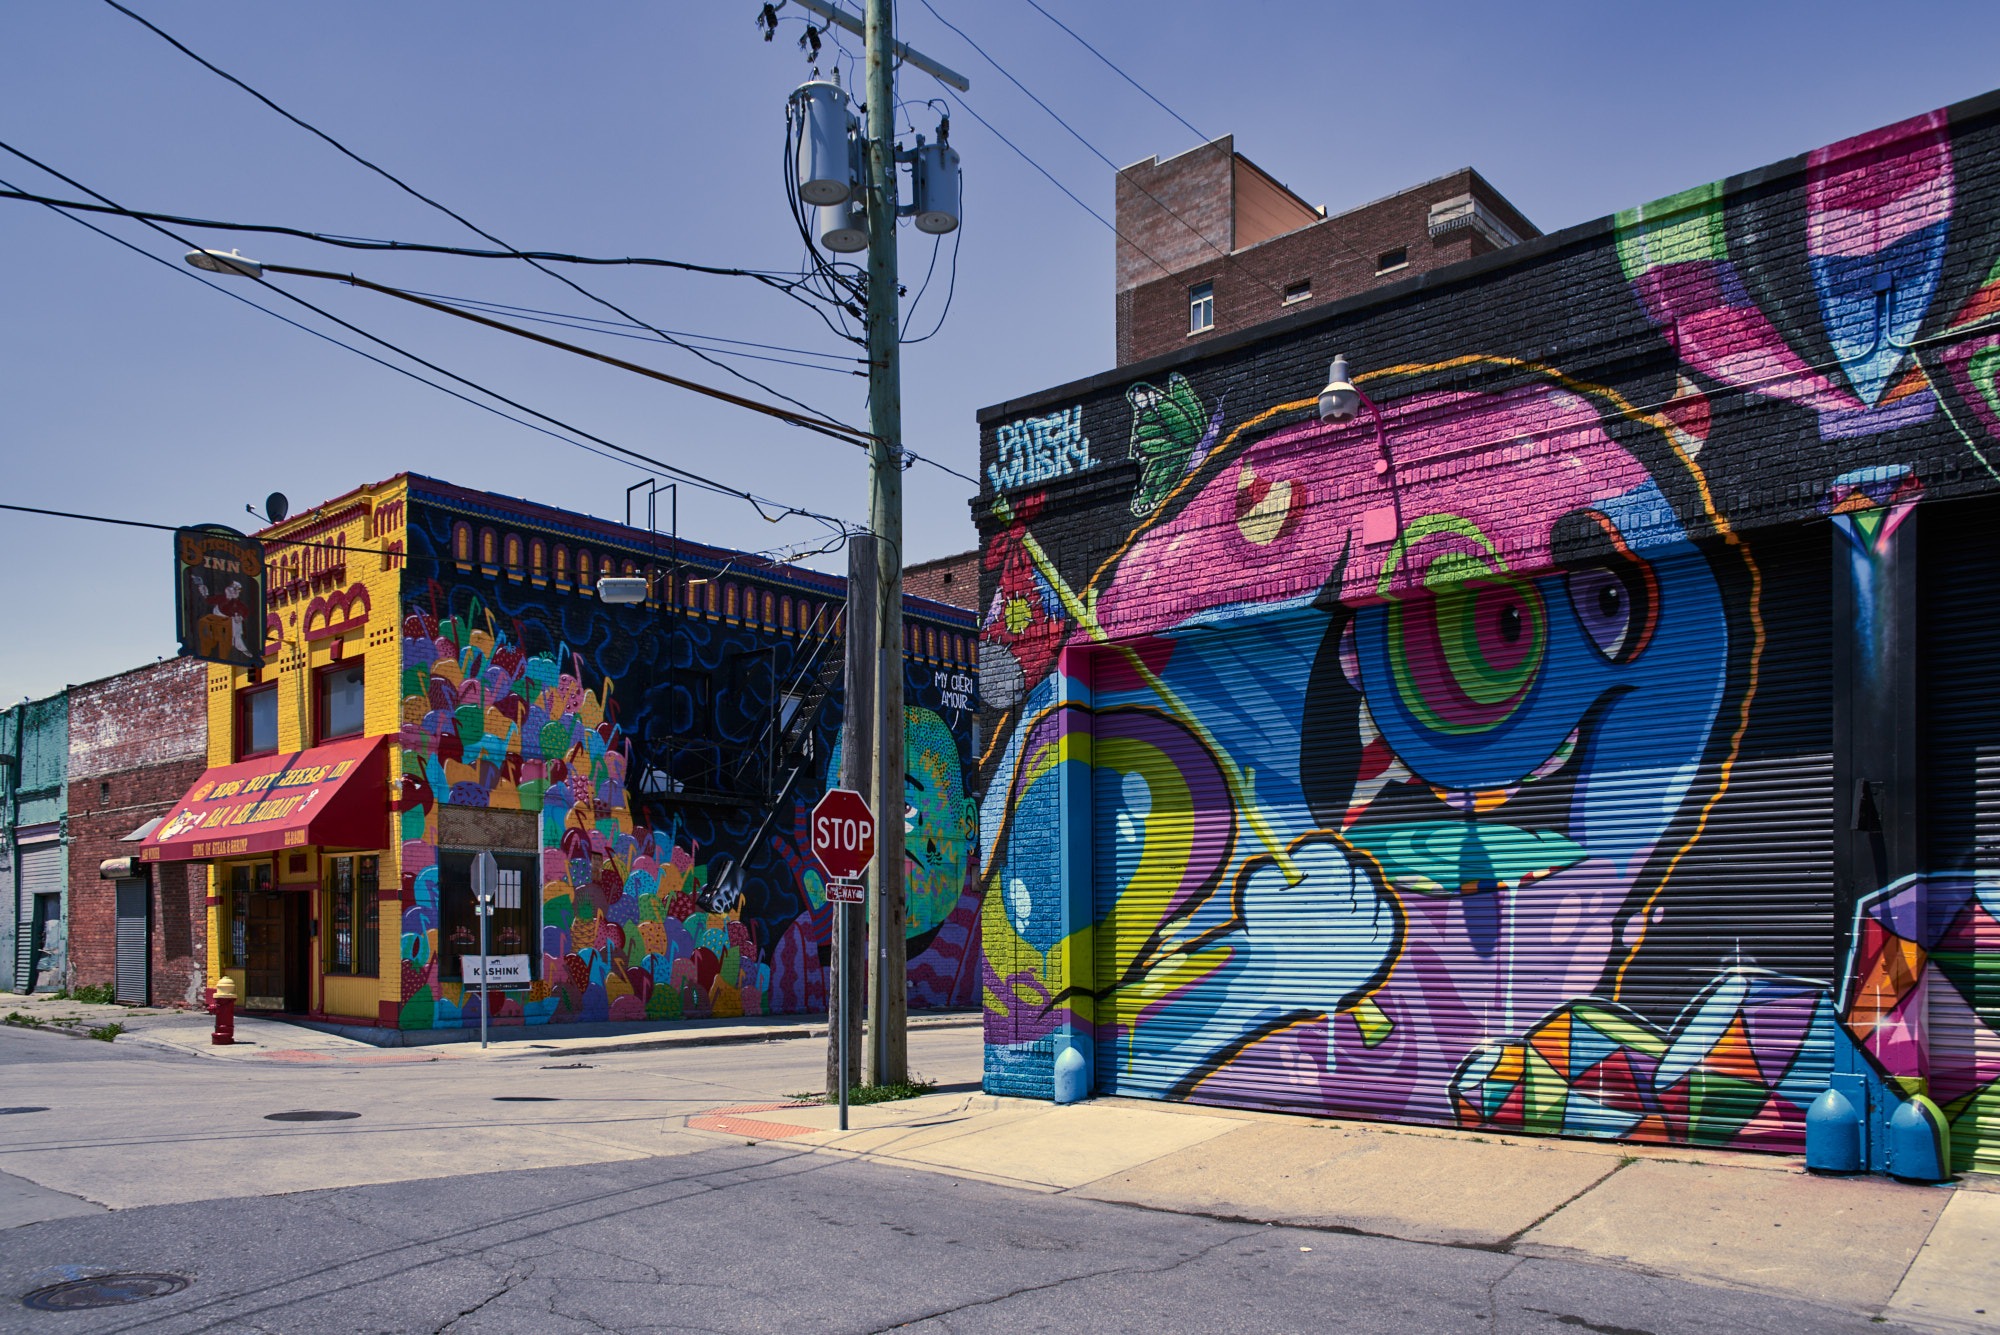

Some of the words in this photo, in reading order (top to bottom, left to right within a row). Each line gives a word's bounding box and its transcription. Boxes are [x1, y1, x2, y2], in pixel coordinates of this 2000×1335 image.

[996, 404, 1082, 462] PATCH
[203, 555, 240, 574] INN
[934, 671, 948, 689] MY
[816, 816, 872, 851] STOP
[473, 967, 519, 976] KSHINK
